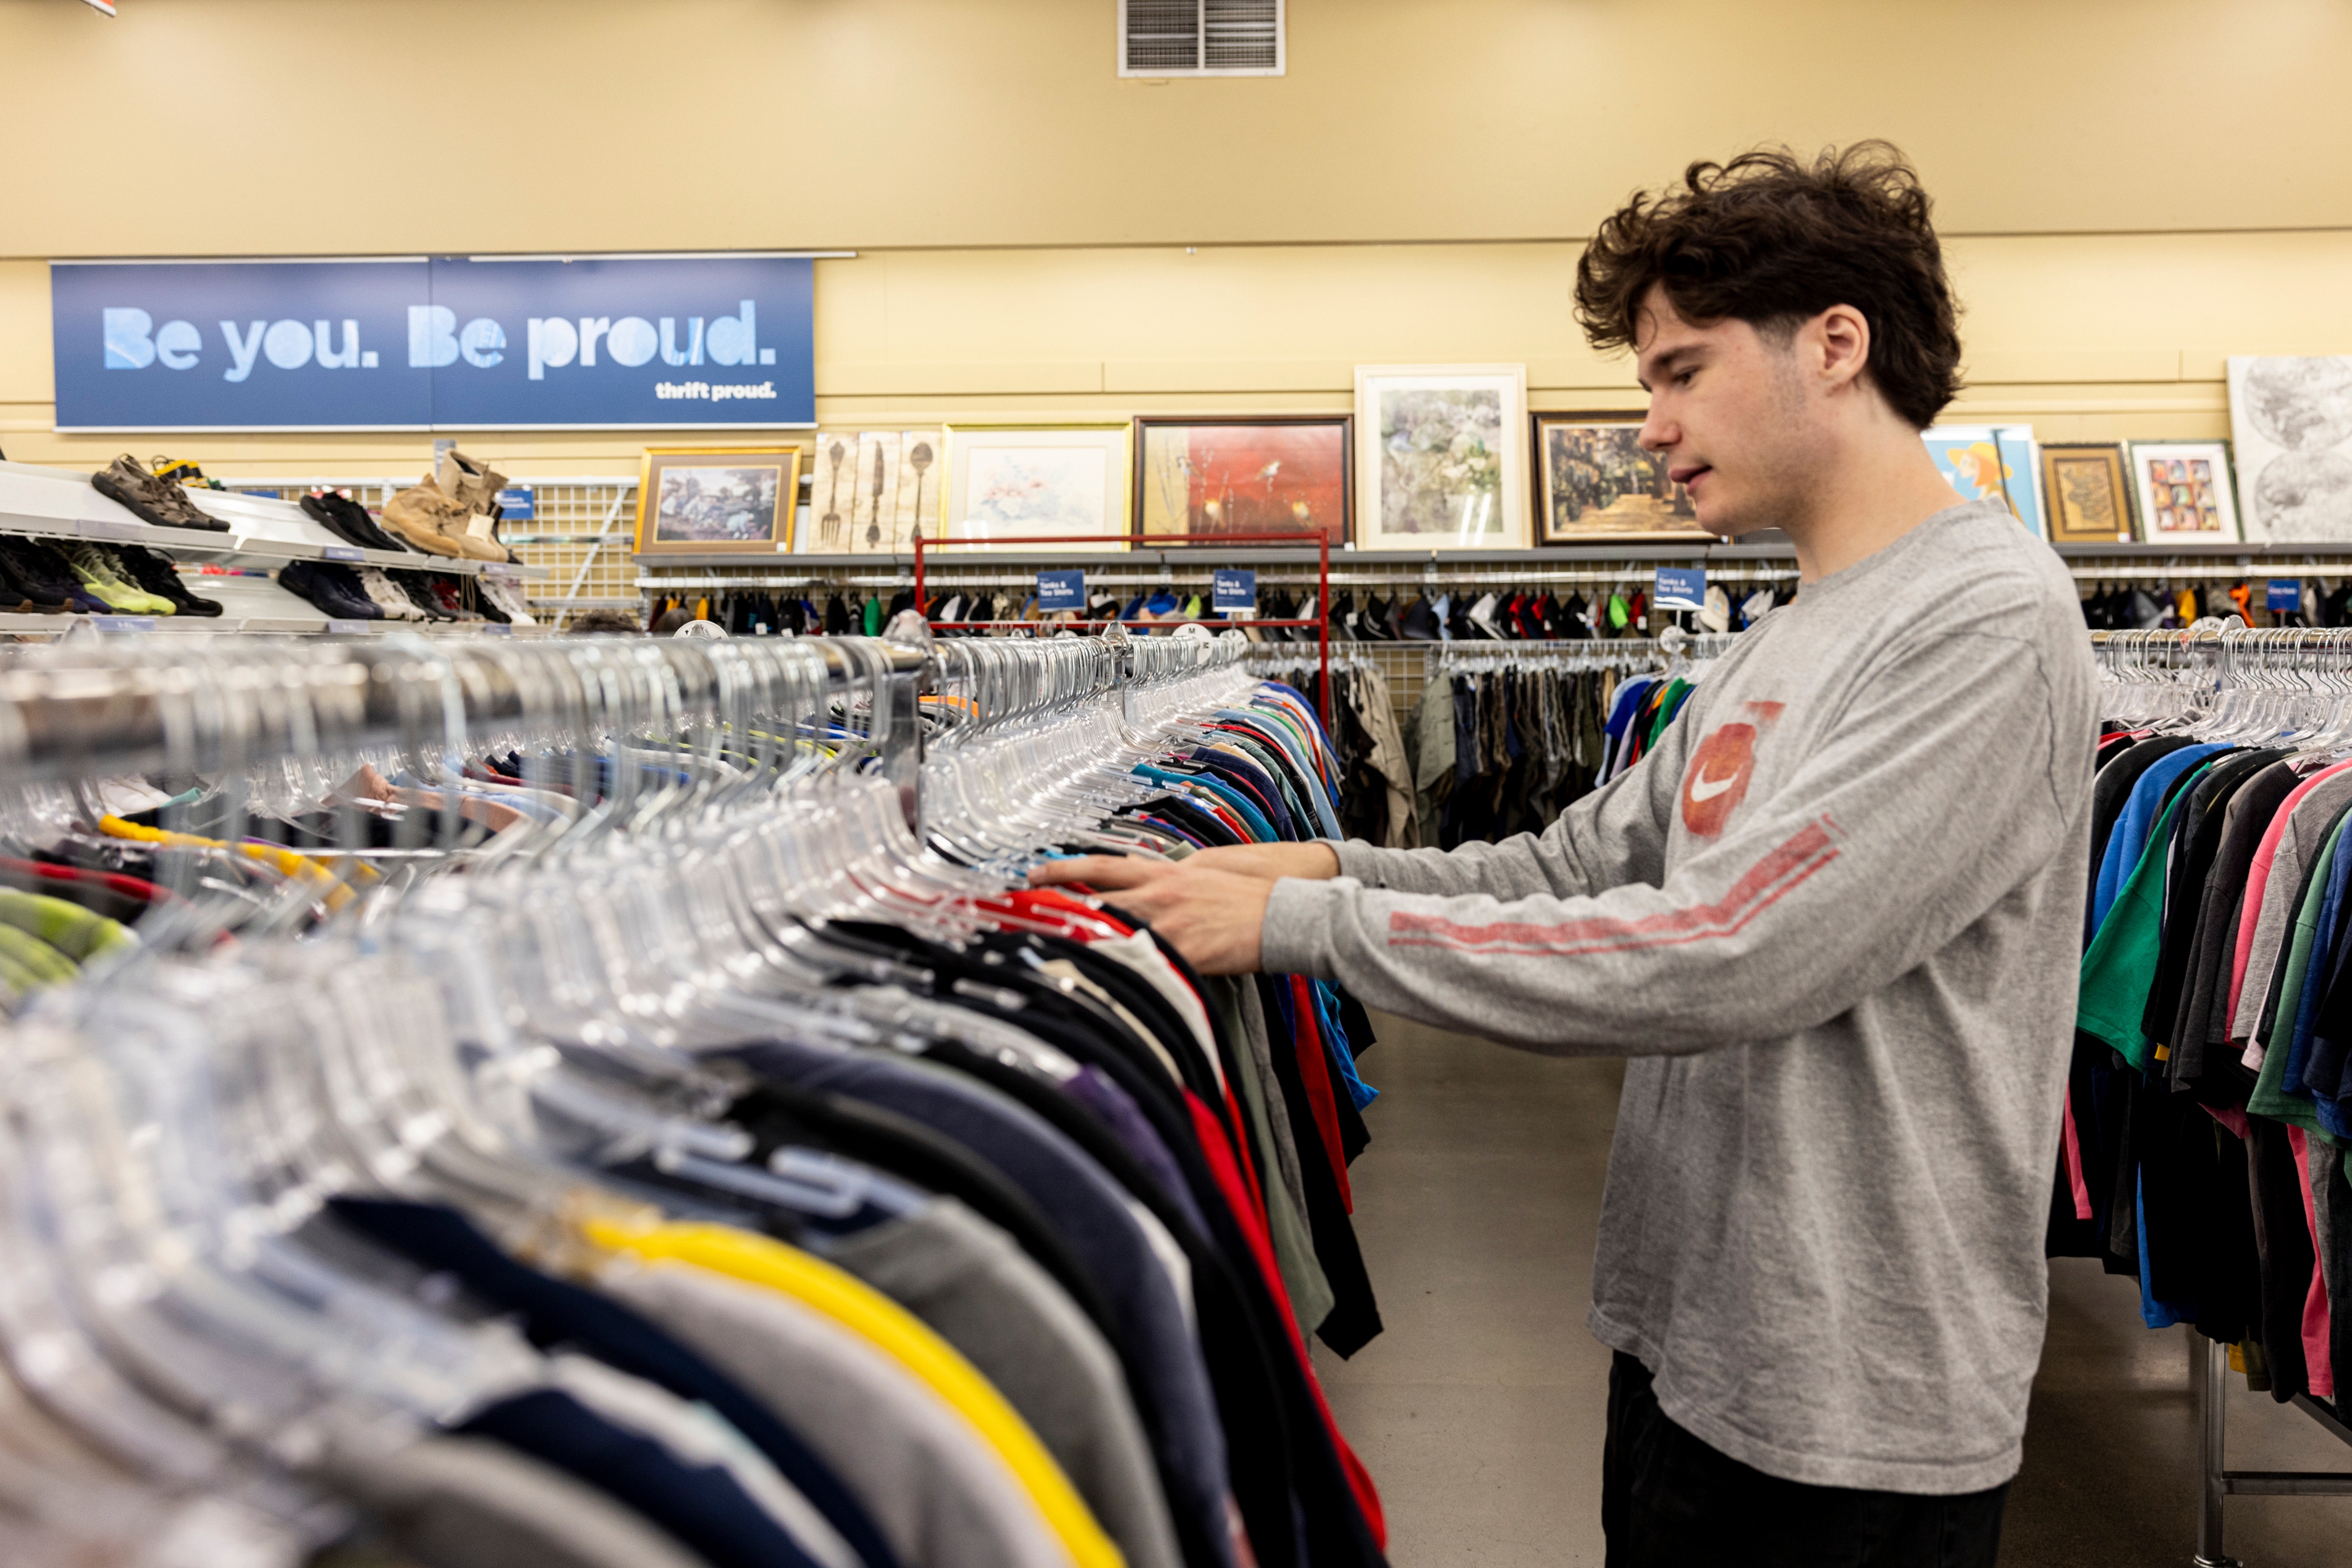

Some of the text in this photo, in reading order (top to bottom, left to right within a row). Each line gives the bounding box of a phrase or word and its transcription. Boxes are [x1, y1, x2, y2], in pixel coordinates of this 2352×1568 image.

[103, 299, 777, 382] Be you. Be proud.
[655, 381, 777, 402] thrift proud.
